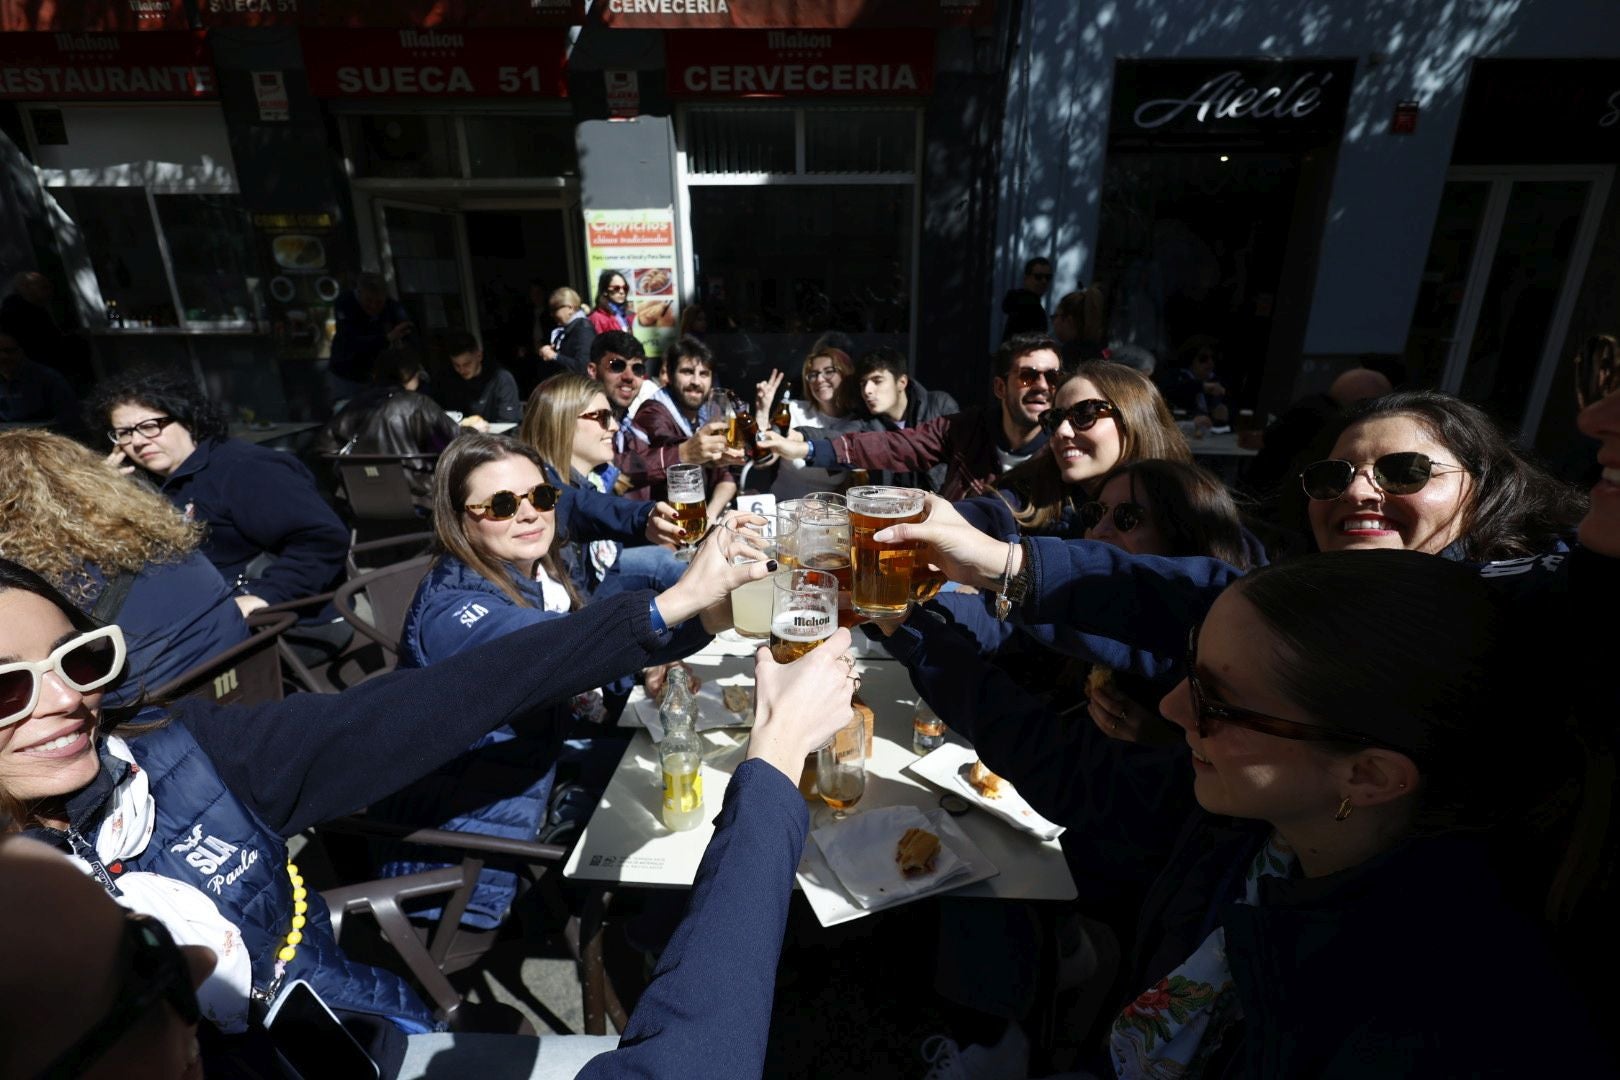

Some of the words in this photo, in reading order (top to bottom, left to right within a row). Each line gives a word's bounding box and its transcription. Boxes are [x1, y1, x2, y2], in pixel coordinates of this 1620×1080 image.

[209, 0, 272, 13] SUECA
[278, 0, 299, 13] 51
[609, 0, 729, 14] CERVECERIA
[54, 32, 120, 51] Mahou
[399, 29, 464, 48] Mahou
[766, 31, 832, 50] Mahou
[0, 65, 213, 93] ESTAURANTE
[336, 65, 475, 93] SUECA
[496, 66, 542, 93] 51
[684, 64, 918, 91] CERVECERIA
[459, 603, 489, 629] SLA
[794, 616, 830, 627] Mahou
[186, 835, 239, 875] SLA
[207, 849, 258, 895] Paula
